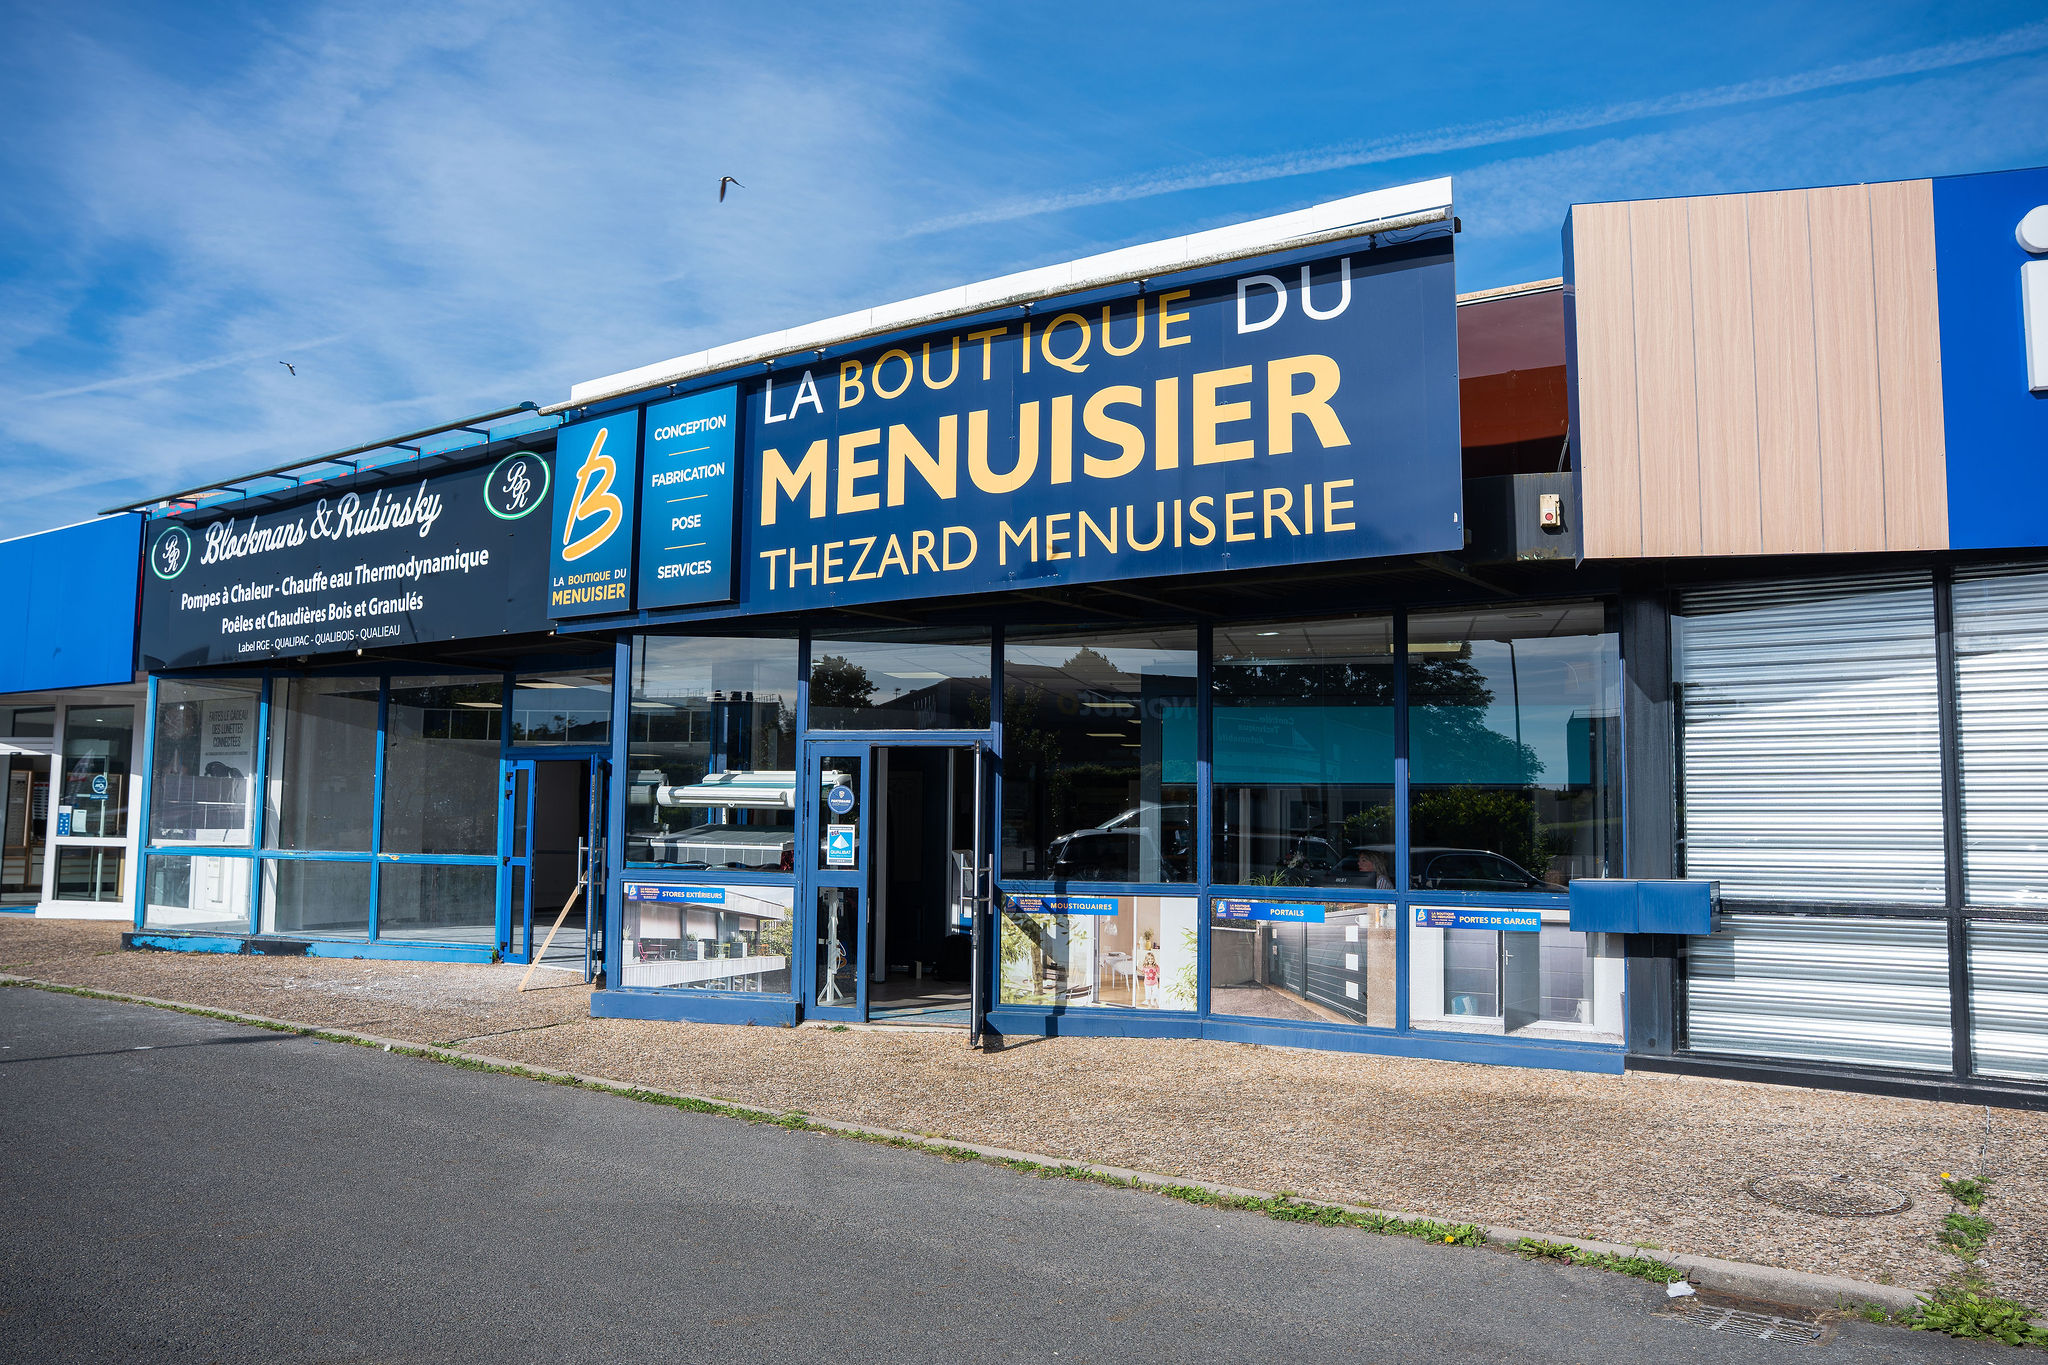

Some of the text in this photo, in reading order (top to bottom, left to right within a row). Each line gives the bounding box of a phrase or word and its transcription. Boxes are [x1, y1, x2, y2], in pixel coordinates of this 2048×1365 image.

[764, 257, 1351, 425] LA BOUTIQUE DU
[654, 414, 727, 441] CONCEPTION
[760, 354, 1352, 526] MENUISIER
[651, 462, 726, 487] FABRICATION
[200, 479, 442, 564] Blockmans & Rubinsky
[671, 514, 702, 531] POSE
[759, 479, 1356, 591] THEZARD MENUISERIE
[181, 590, 221, 611] Pompes
[222, 587, 229, 605] à
[230, 580, 274, 603] Chaleur
[281, 572, 328, 597] Chauffe
[330, 570, 352, 589] eau
[354, 548, 489, 583] Thermodynamique
[553, 568, 627, 587] LA BOUTIQUE DU
[657, 560, 712, 579] SERVICES
[551, 583, 626, 606] MENUISIER
[221, 591, 423, 634] Poêles et Chaudières Bois et Granulés
[238, 637, 256, 653] Label
[256, 638, 271, 651] RGE
[275, 633, 310, 650] QUALIPAC
[315, 629, 355, 646] QUALIBOIS
[360, 624, 401, 641] QUALIEAU
[686, 891, 722, 899] EXTÉRIEURS
[1050, 902, 1113, 911] MOUSTIQUAIRES
[1270, 908, 1305, 917] PORTAILS
[1459, 916, 1489, 924] PORTES
[1490, 917, 1502, 925] DE
[1503, 917, 1538, 926] GARAGE
